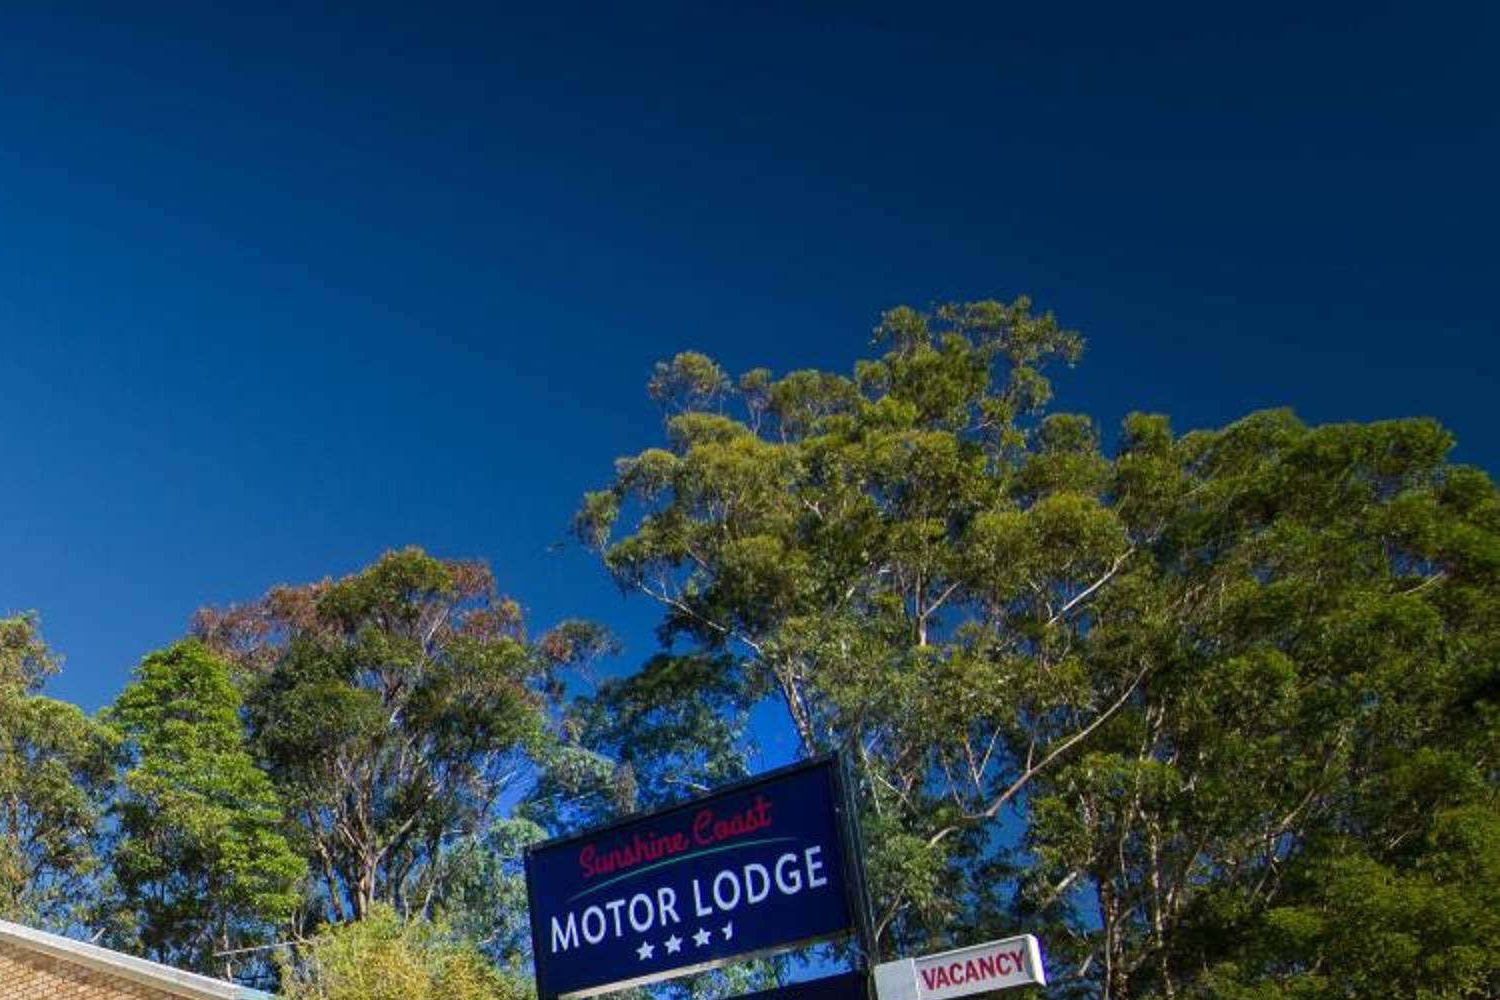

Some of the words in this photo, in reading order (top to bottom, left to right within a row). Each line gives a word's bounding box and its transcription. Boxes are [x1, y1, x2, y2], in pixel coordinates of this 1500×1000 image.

[579, 831, 689, 878] Sunshine
[692, 798, 773, 845] Coast
[551, 887, 680, 953] MOTOR
[693, 845, 827, 917] LODGE
[921, 949, 1025, 990] VACANCY
